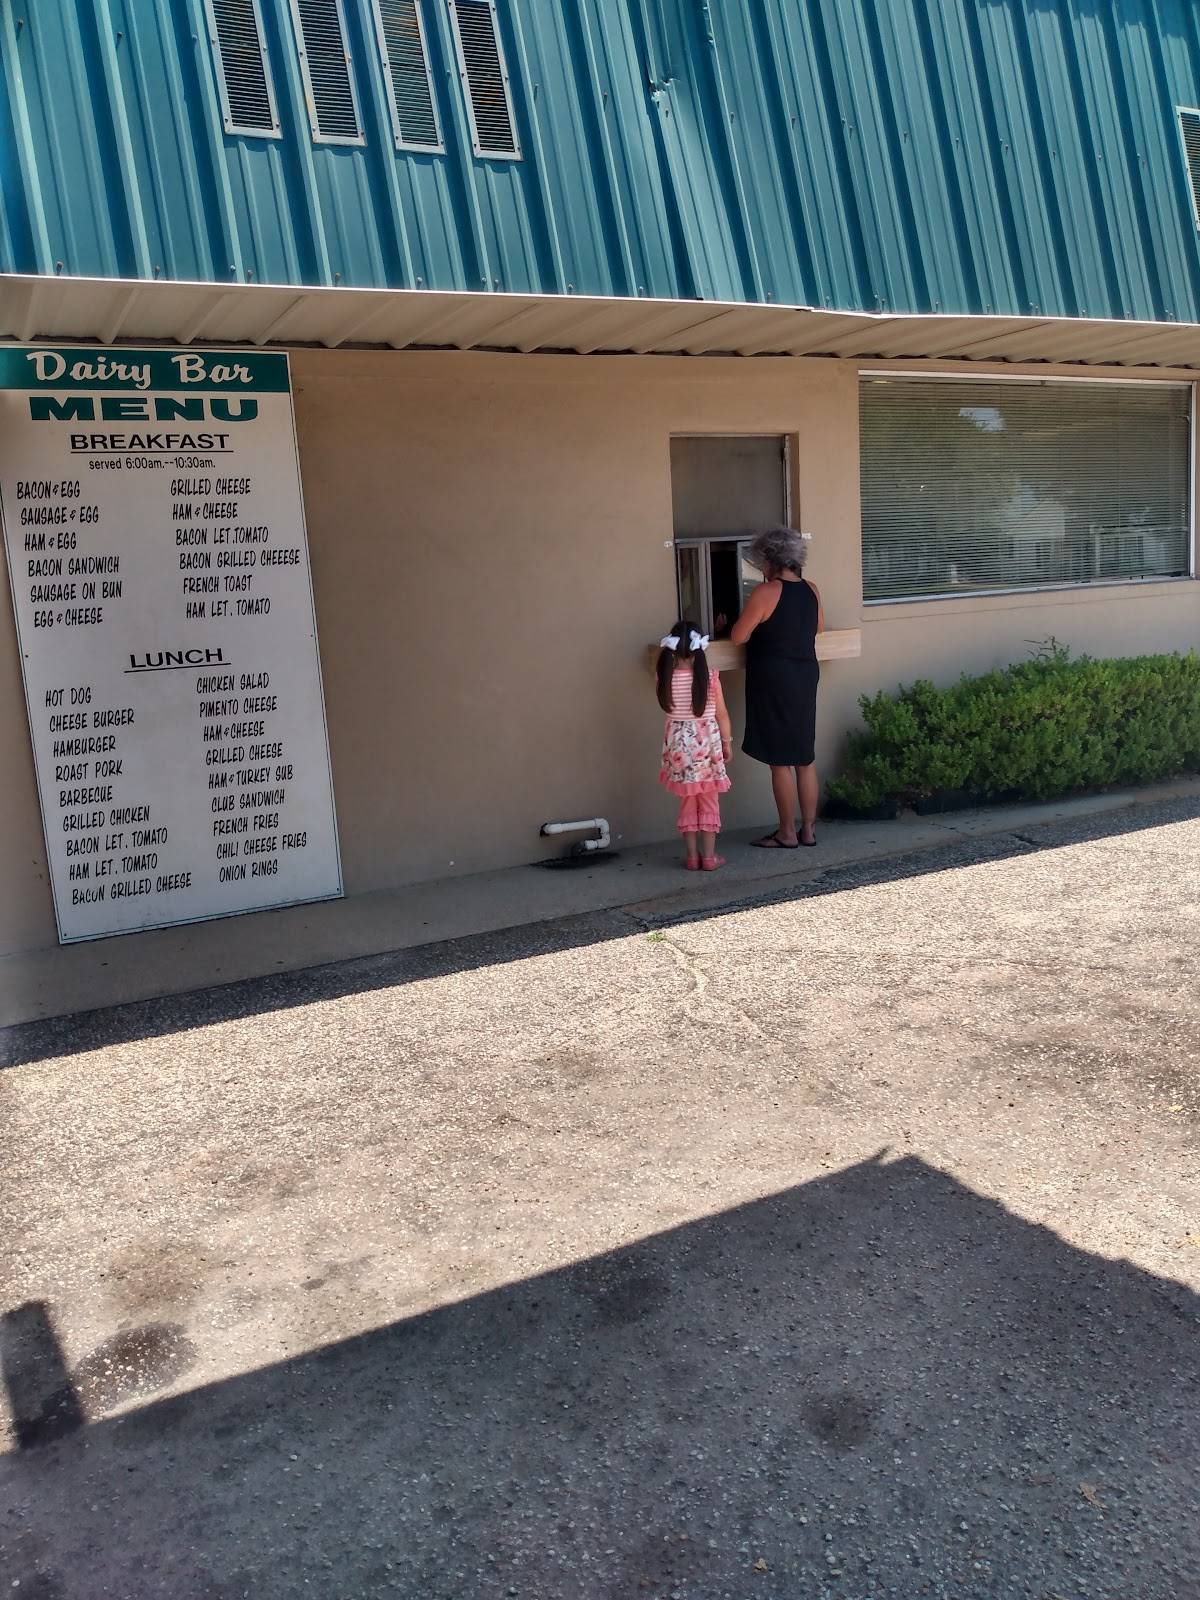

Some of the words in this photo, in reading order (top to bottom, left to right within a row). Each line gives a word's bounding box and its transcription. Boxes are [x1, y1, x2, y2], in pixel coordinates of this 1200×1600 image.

[26, 351, 152, 389] Dairy
[172, 353, 253, 383] Bar
[29, 396, 258, 421] MENU
[70, 433, 230, 450] BREAKFAST
[89, 457, 122, 470] served
[17, 480, 52, 500] BACON
[60, 480, 80, 498] EGG
[170, 478, 211, 496] GRILLED
[215, 477, 251, 495] CHEESE
[20, 506, 68, 526] SAUSAGE
[79, 505, 99, 524] EGG
[172, 503, 192, 520] HAM
[202, 502, 238, 520] CHEESE
[24, 533, 46, 551] HAM
[57, 532, 77, 550] EGG
[176, 528, 208, 546] BACON
[28, 558, 63, 577] BACON
[68, 556, 120, 575] SANDWICH
[179, 552, 211, 570] BACON
[217, 550, 256, 568] GRILLED
[260, 548, 300, 567] CHEEESE
[30, 583, 77, 603] SAUSAGE
[82, 581, 96, 600] ON
[102, 580, 122, 599] BUN
[183, 576, 220, 595] FRENCH
[224, 574, 253, 592] TOAST
[34, 610, 54, 628] EGG
[65, 607, 103, 626] CHEESE
[186, 601, 206, 619] HAM
[236, 597, 271, 616] TOMATO
[129, 648, 223, 668] LUNCH
[196, 674, 235, 694] CHICKEN
[240, 672, 270, 691] SALAD
[45, 688, 65, 708] HOT
[70, 686, 92, 705] DOG
[199, 698, 239, 718] PIMENTO
[243, 695, 277, 714] CHEESE
[49, 712, 88, 733] CHEESE
[93, 708, 135, 728] BURGER
[203, 724, 223, 742] HAM
[230, 720, 265, 739] CHEESE
[53, 735, 116, 758] HAMBURGER
[205, 746, 245, 766] GRILLED
[249, 742, 283, 761] CHEESE
[55, 762, 89, 783] ROAST
[95, 759, 123, 778] PORK
[208, 772, 228, 789] HAM
[236, 766, 271, 786] TURKEY
[275, 764, 294, 782] SUB
[59, 785, 113, 808] BARBECUE
[211, 795, 235, 813] CLUB
[239, 788, 285, 809] SANDWICH
[63, 811, 105, 832] GRILLED
[109, 805, 150, 826] CHICKEN
[213, 817, 248, 837] FRENCH
[253, 812, 279, 831] FRIES
[66, 836, 100, 857] BACON
[131, 827, 168, 848] TOMATO
[216, 841, 239, 860] CHILI
[243, 836, 277, 856] CHEESE
[282, 831, 307, 850] FRIES
[69, 862, 90, 881] HAM
[121, 852, 158, 873] TOMATO
[219, 863, 247, 883] ONION
[251, 858, 278, 878] RINGS
[72, 884, 105, 905] BACON
[110, 878, 152, 900] GRILLED
[156, 872, 192, 893] CHEESE
